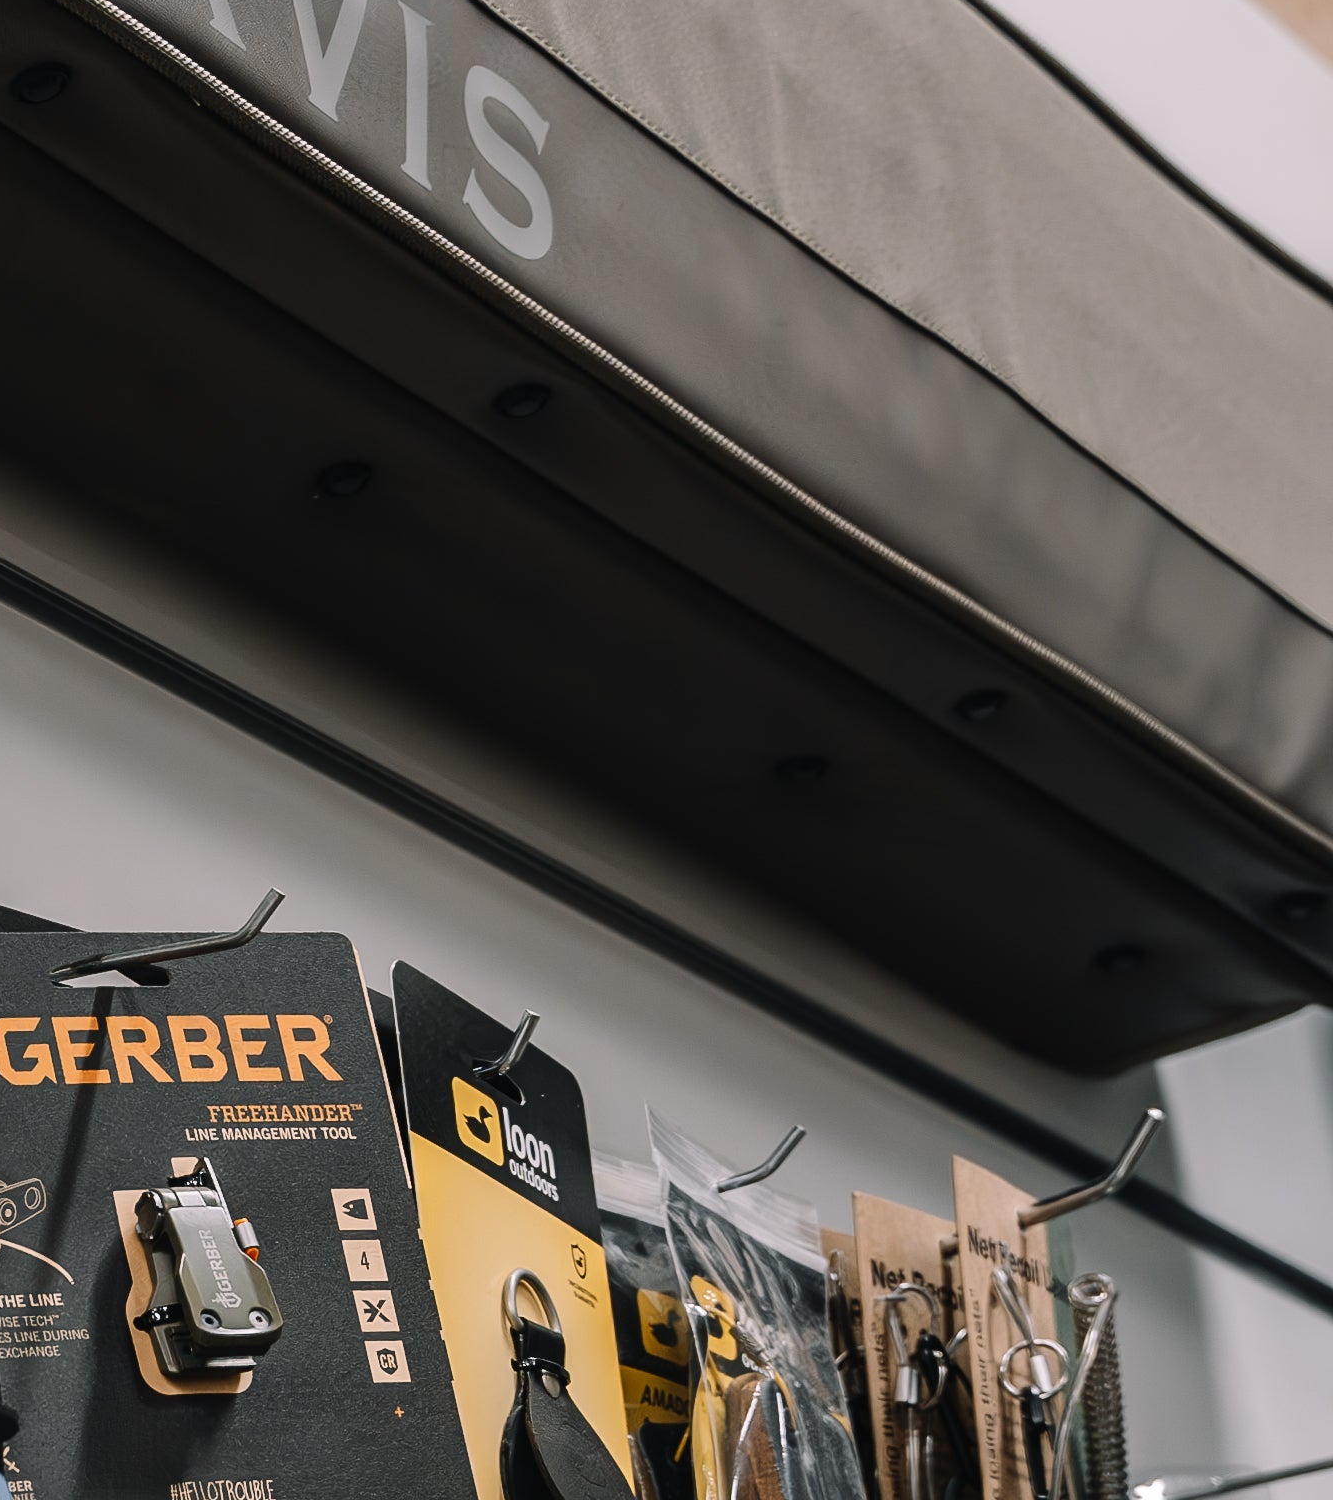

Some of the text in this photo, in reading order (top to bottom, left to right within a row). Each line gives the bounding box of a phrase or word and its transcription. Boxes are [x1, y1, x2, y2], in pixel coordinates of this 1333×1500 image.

[185, 1126, 358, 1142] LINE MANAGEMENT TOOL
[501, 1106, 557, 1180] loon
[508, 1158, 560, 1202] outdoors
[198, 1229, 232, 1299] GERBER
[359, 1250, 370, 1271] 4
[29, 1292, 64, 1307] LINE
[14, 1329, 90, 1343] LINE DURING
[379, 1352, 398, 1370] CR
[7, 1479, 33, 1493] BER
